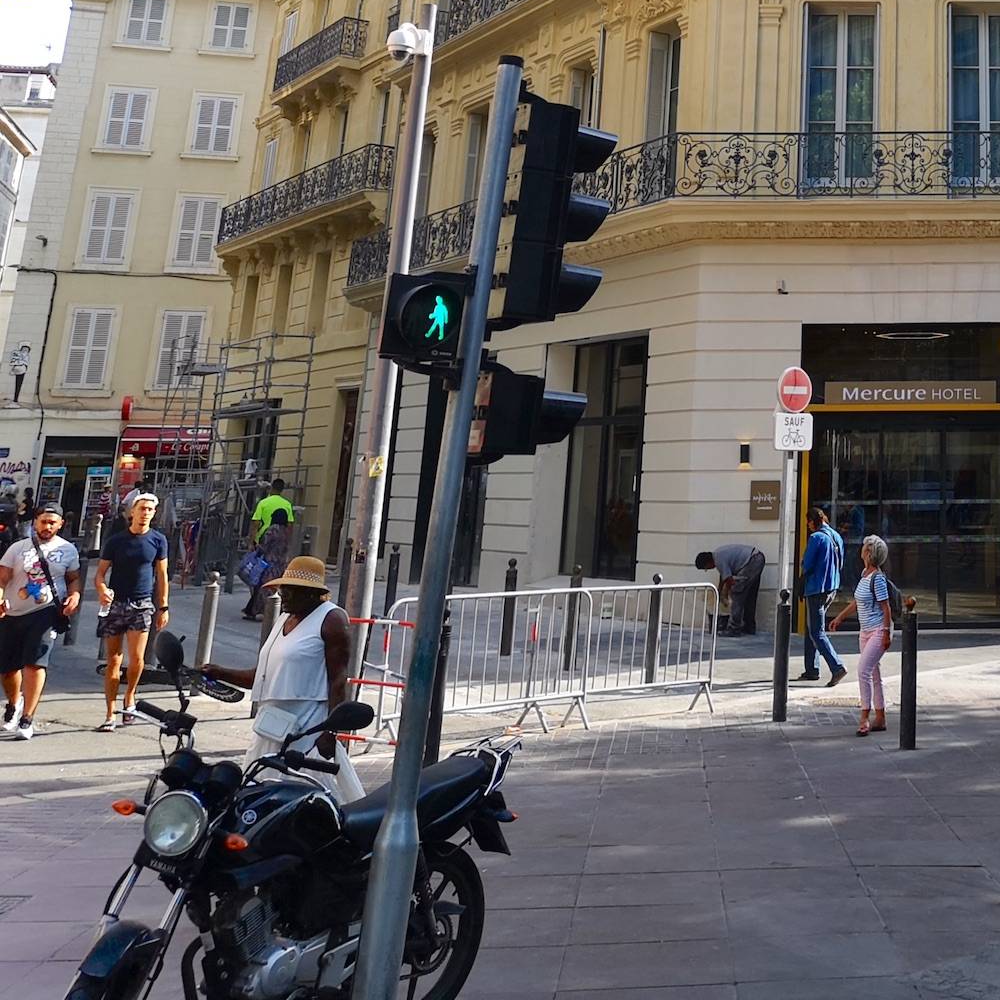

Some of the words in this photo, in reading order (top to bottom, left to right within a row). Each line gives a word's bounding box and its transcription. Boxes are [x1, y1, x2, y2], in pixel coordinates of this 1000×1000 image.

[842, 387, 926, 401] Mercure
[931, 388, 981, 400] HOTEL
[784, 416, 805, 426] SAUF
